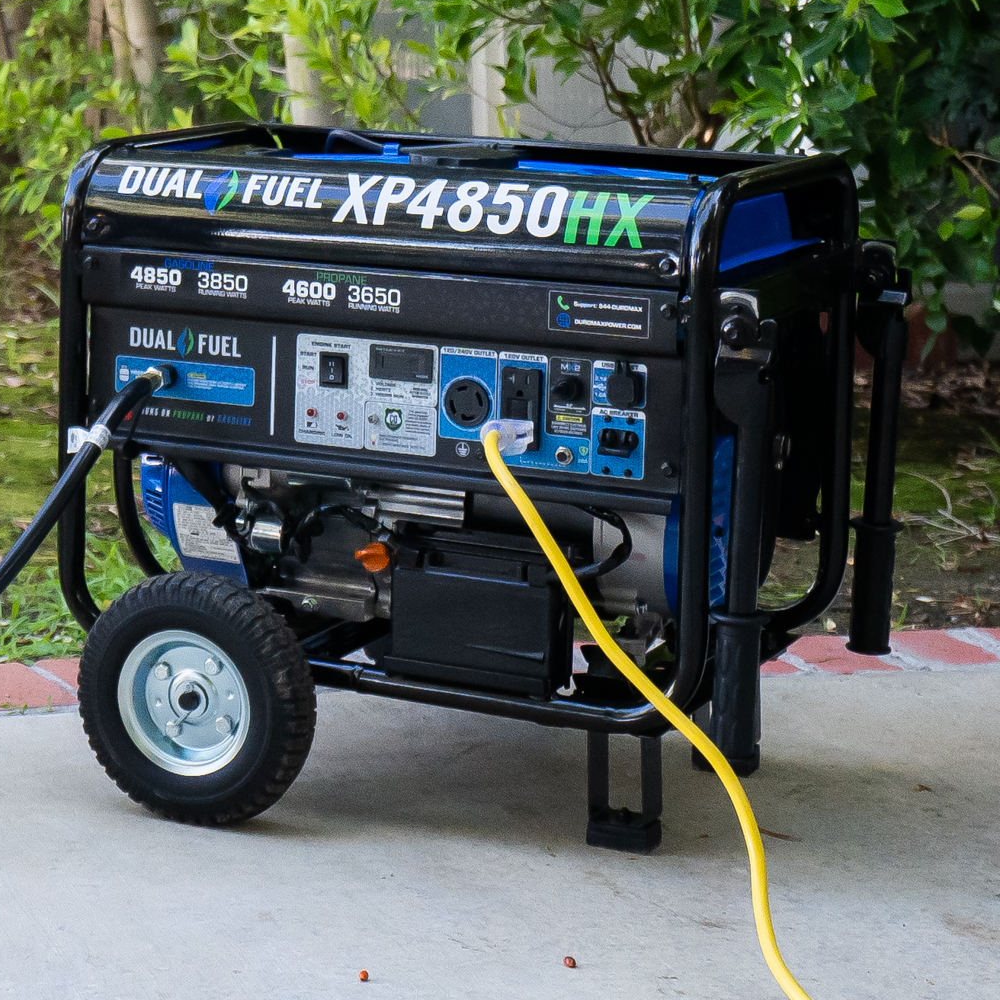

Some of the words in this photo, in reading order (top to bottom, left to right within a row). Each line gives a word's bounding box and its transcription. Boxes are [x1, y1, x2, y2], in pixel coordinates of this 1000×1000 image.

[118, 165, 204, 199] DUAL
[242, 174, 323, 209] FUEL
[332, 173, 655, 249] XP4850HX
[164, 258, 214, 271] GASOLINE
[130, 265, 182, 286] 4850
[197, 271, 249, 292] 3850
[316, 272, 367, 285] PROPANE
[135, 282, 153, 290] PEAK
[153, 284, 177, 293] WATTS
[282, 279, 336, 300] 4600
[348, 285, 401, 306] 3650
[197, 288, 226, 297] RUNNING
[226, 291, 247, 299] WATTS
[287, 296, 305, 305] PEAK
[306, 299, 331, 307] WATTS
[348, 302, 377, 311] RUNNING
[377, 305, 400, 314] WATTS
[574, 319, 642, 330] DUROMAXPOWER.COM
[129, 326, 176, 351] DUAL
[198, 333, 242, 358] FUEL
[443, 347, 473, 356] 120/240V
[473, 350, 495, 358] OUTLET
[521, 355, 544, 363] OUTLET
[609, 409, 639, 418] BREAKER
